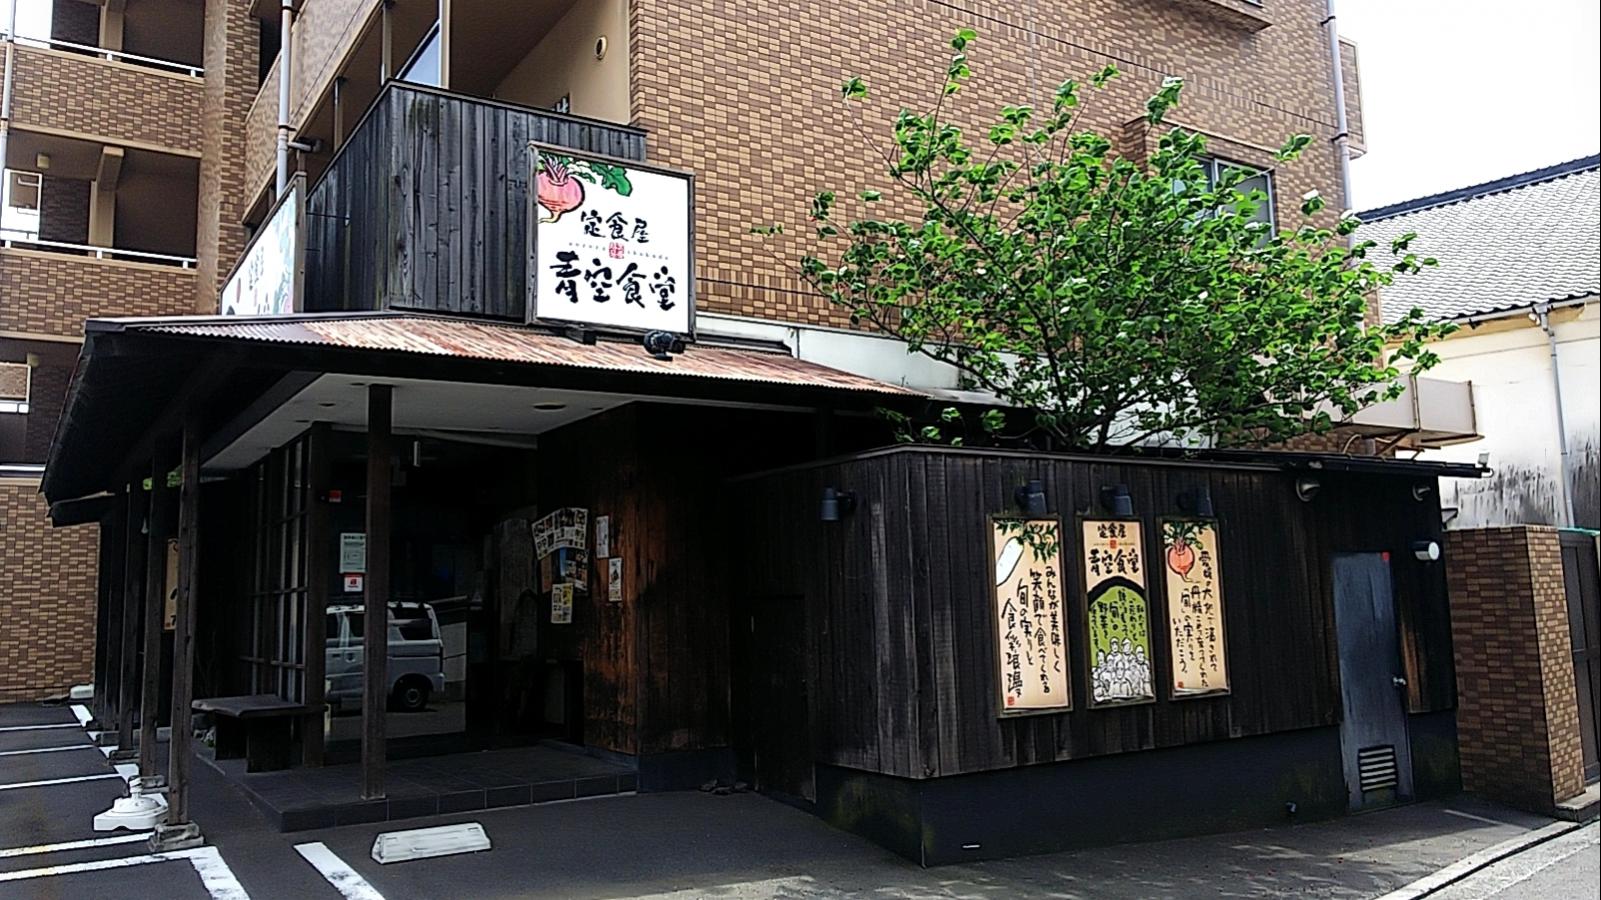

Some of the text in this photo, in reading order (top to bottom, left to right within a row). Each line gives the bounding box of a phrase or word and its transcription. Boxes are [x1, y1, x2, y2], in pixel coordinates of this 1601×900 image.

[581, 209, 650, 244] 定食屋
[549, 250, 676, 311] 青空食堂
[1097, 522, 1127, 538] 定食屋
[1088, 547, 1139, 576] 青空食堂
[1030, 567, 1050, 693] 笑顔で食べてくれる
[1046, 565, 1061, 673] みんなが美味しく
